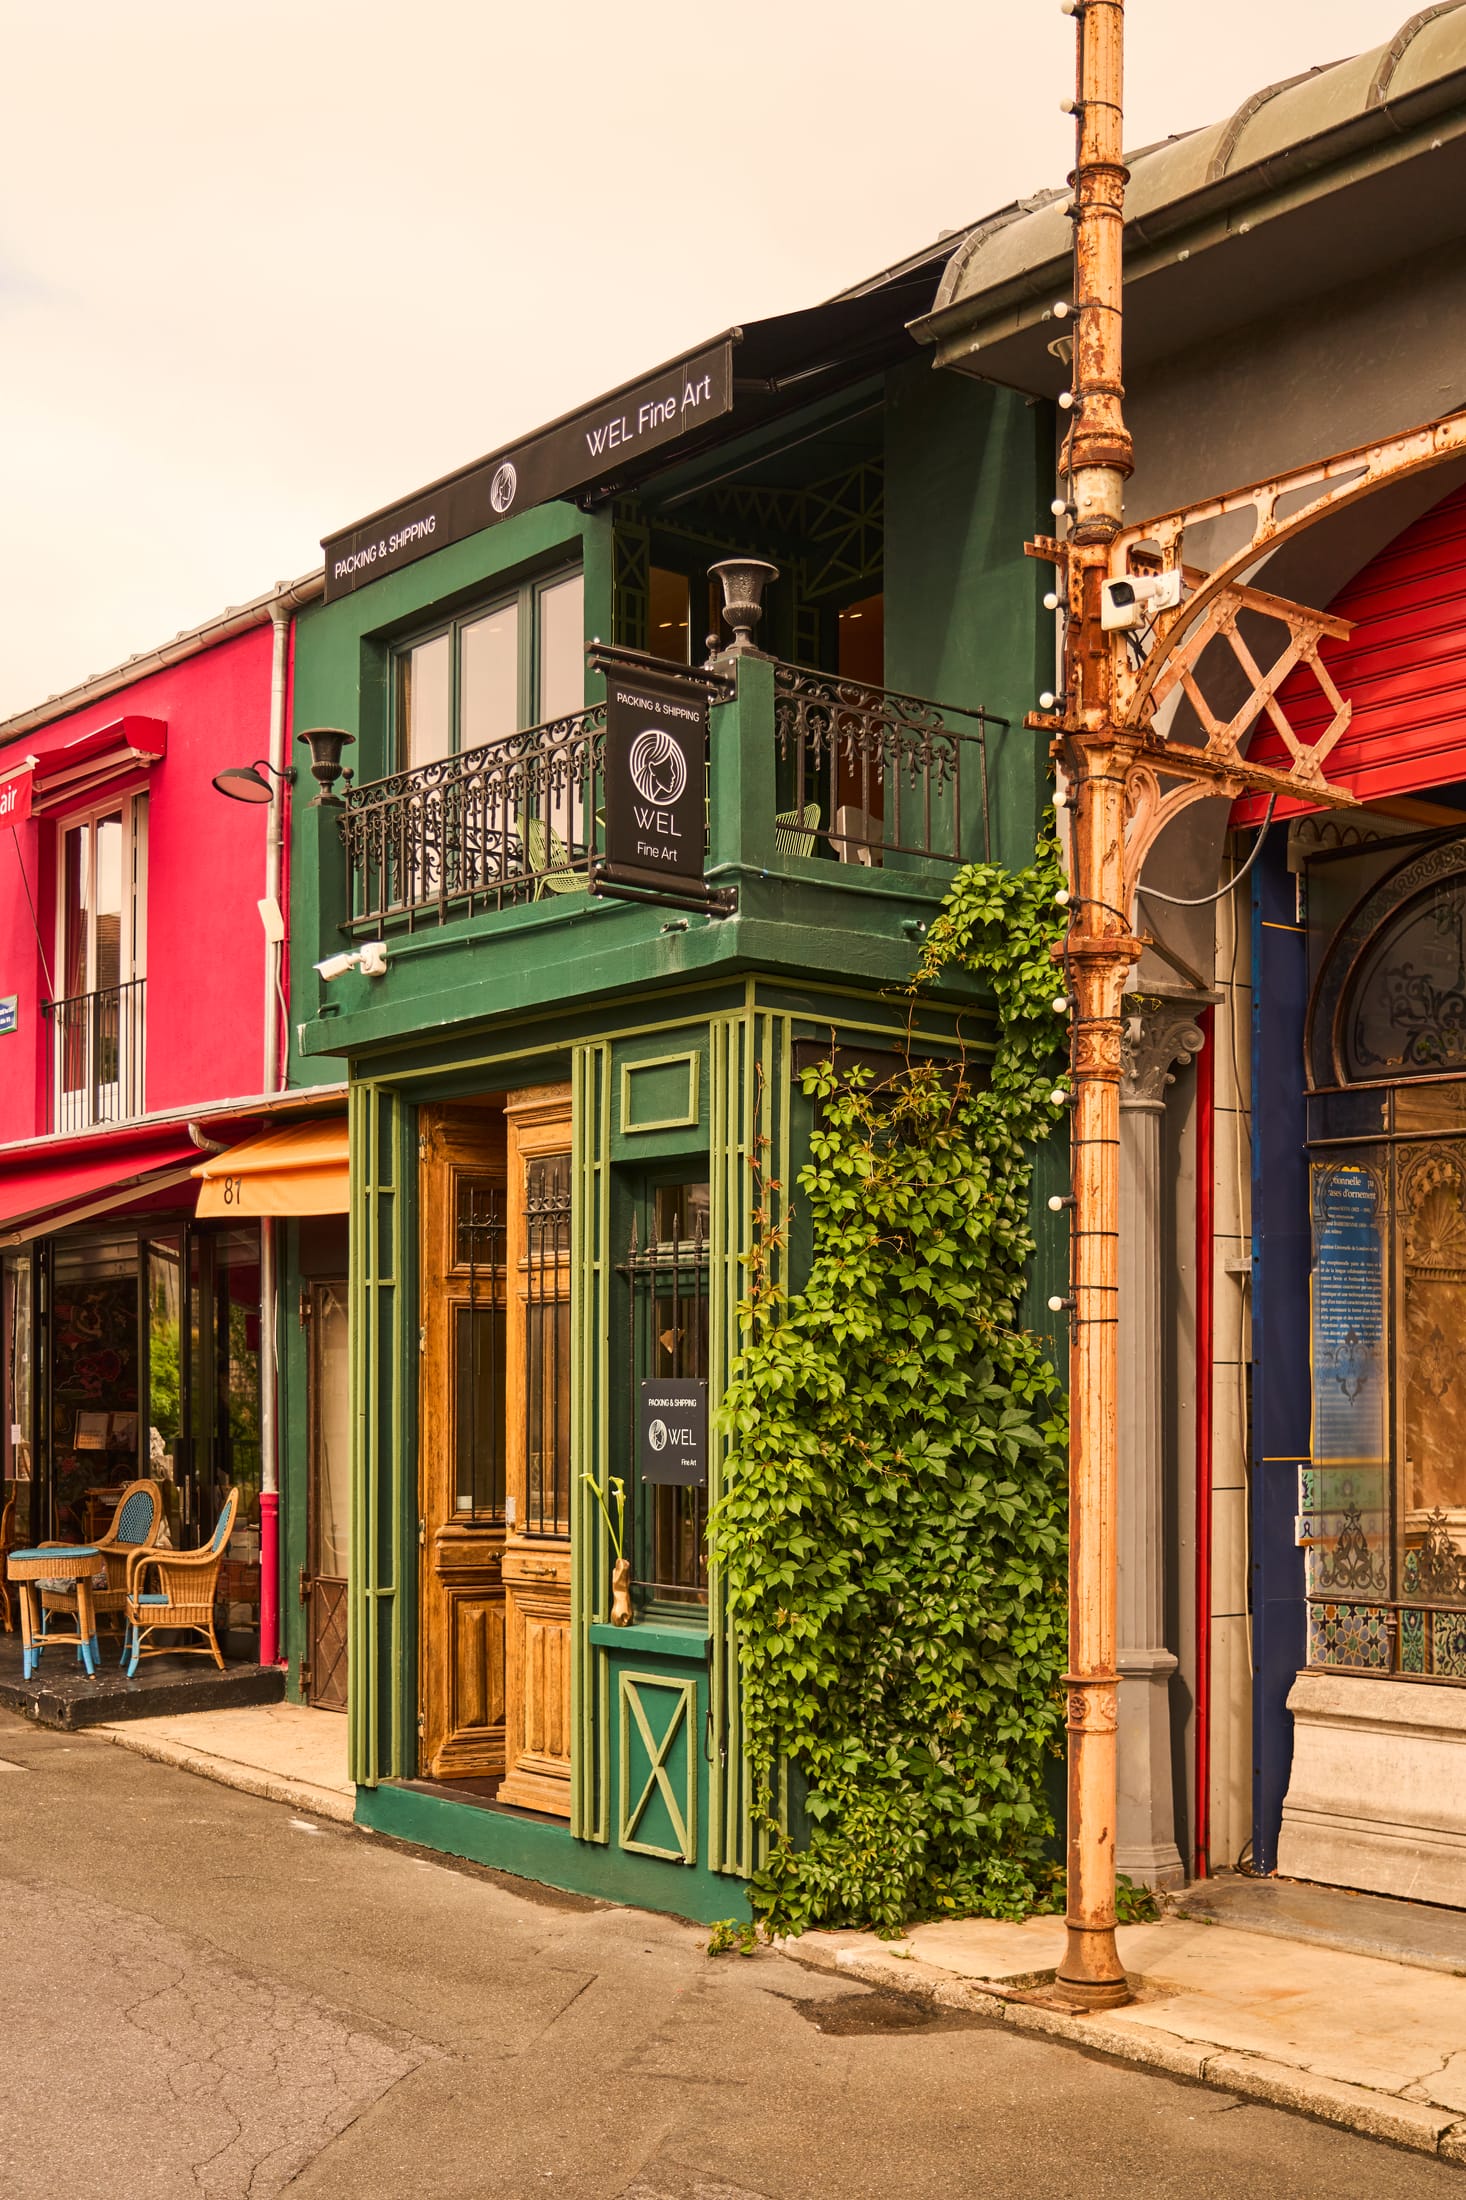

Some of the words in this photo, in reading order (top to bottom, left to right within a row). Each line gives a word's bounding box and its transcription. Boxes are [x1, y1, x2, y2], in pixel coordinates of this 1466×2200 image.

[586, 416, 634, 457] WEL
[638, 397, 677, 435] Fine
[681, 375, 711, 413] Art
[335, 545, 377, 580] PACKING
[378, 541, 388, 558] &
[389, 515, 436, 553] SHIPPING
[617, 692, 654, 711] PACKING
[654, 702, 662, 713] &
[662, 704, 700, 722] SHIPPING
[633, 805, 682, 837] WEL
[637, 841, 660, 858] Fine
[661, 846, 678, 862] Art
[223, 1175, 243, 1205] 81
[648, 1398, 670, 1407] PACKING
[674, 1398, 697, 1407] SHIPPING
[668, 1428, 697, 1446] WEL
[681, 1458, 690, 1466] Fine
